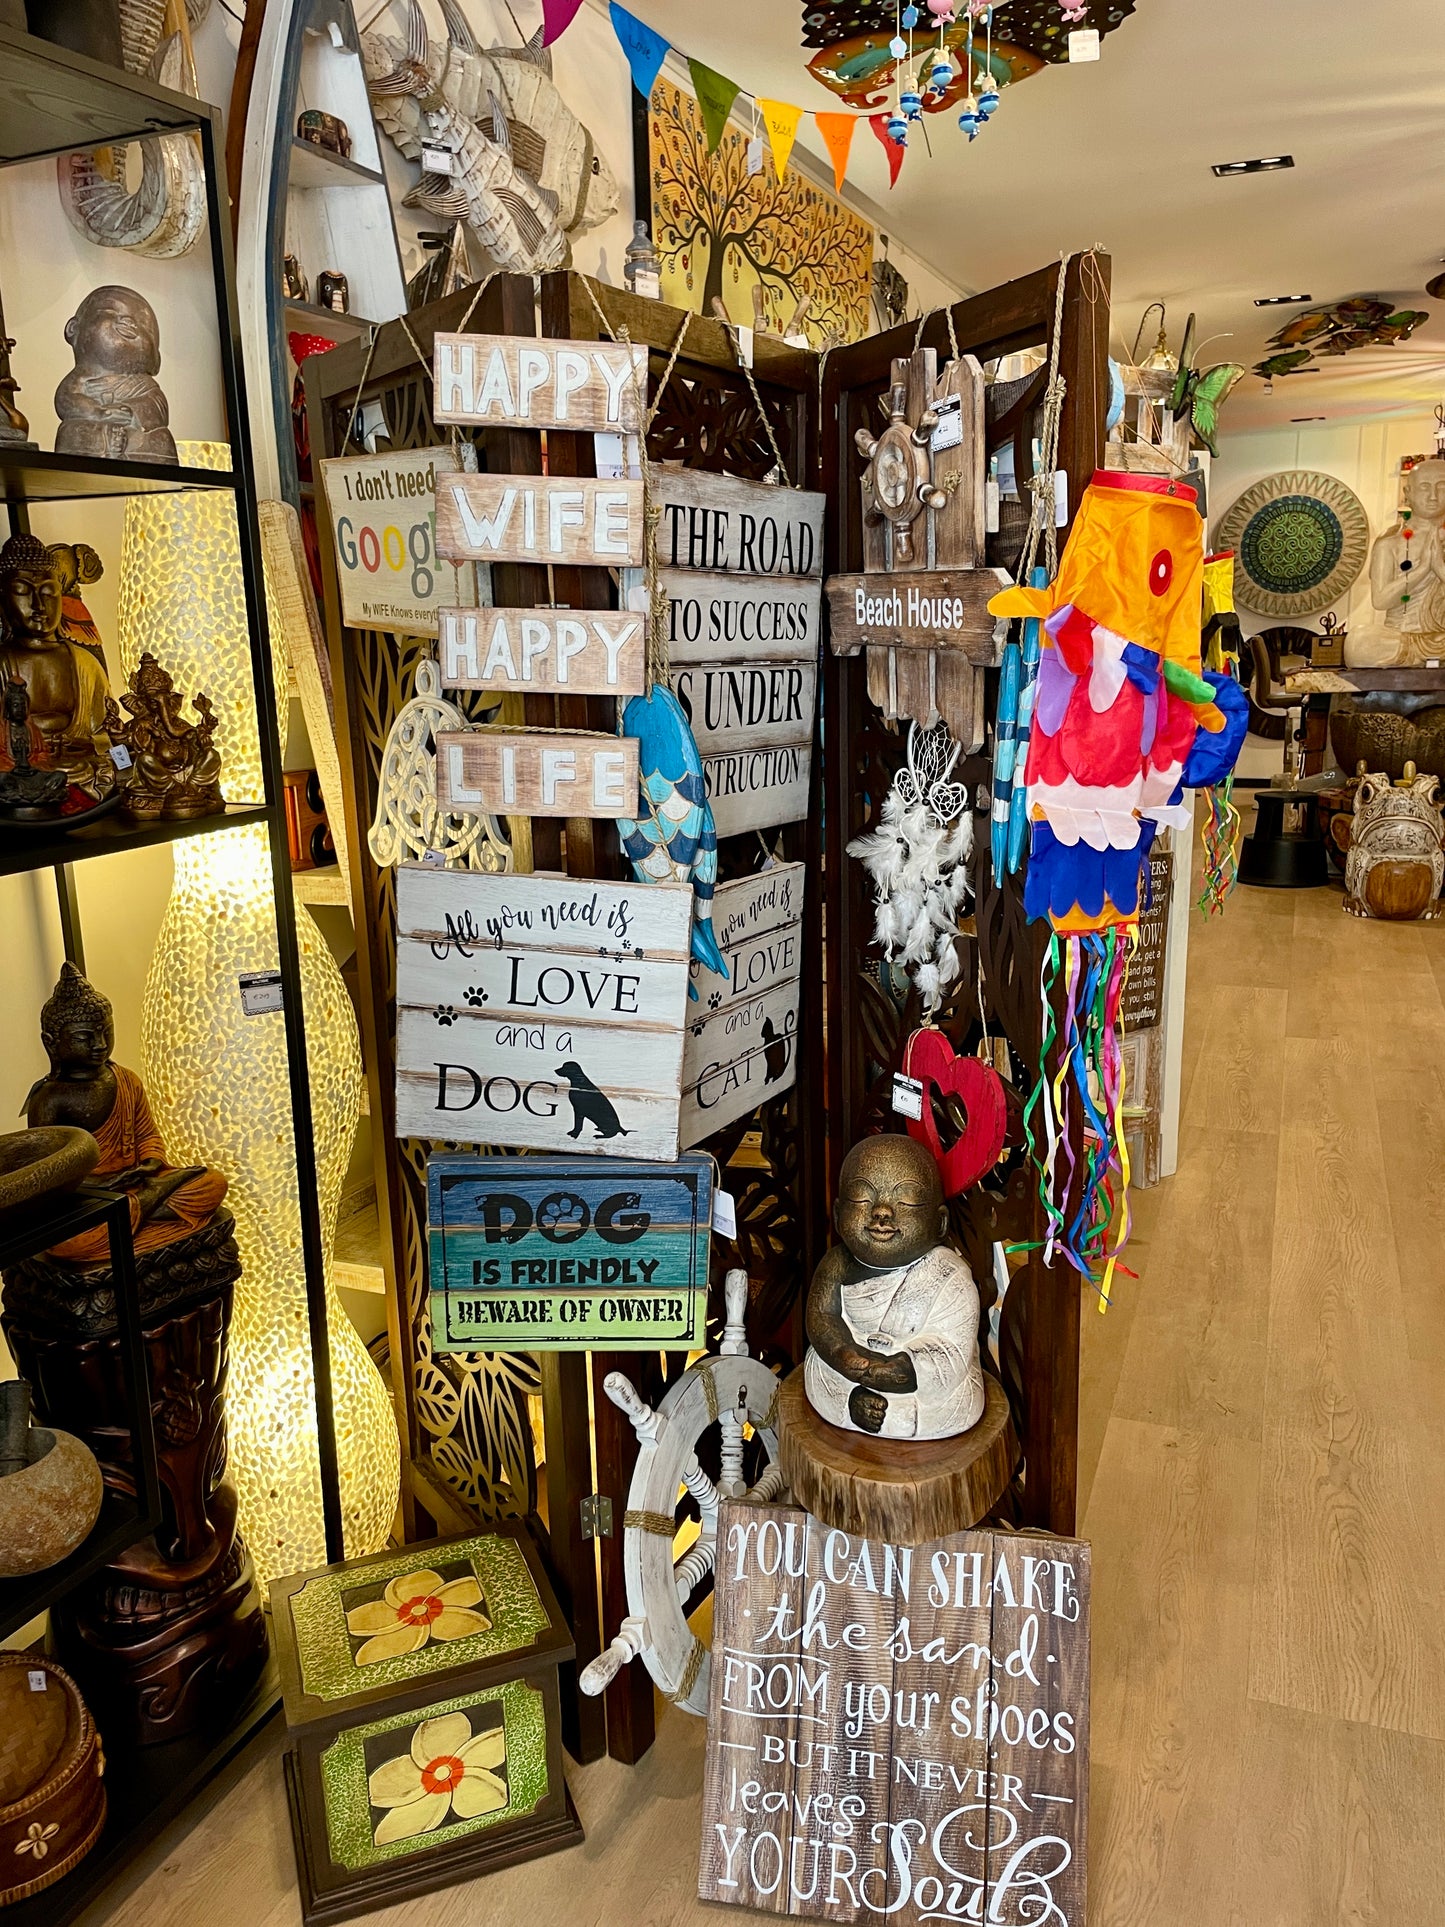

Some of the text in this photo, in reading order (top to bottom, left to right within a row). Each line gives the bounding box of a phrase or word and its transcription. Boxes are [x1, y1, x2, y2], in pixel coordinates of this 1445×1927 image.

[440, 344, 643, 422] HAPPY
[344, 462, 436, 502] I don't need
[451, 487, 629, 554] WIFE
[664, 503, 814, 575] THE ROAD
[362, 602, 371, 618] My
[373, 603, 390, 617] WIFE
[390, 605, 414, 620] Knows
[668, 599, 808, 642] TO SUCCESS
[855, 588, 964, 629] Beach House
[446, 616, 640, 684] HAPPY
[668, 668, 803, 732] S UNDER
[449, 746, 625, 807] LIFE
[430, 892, 633, 960] All you need is
[721, 878, 793, 953] you need is
[507, 956, 641, 1013] LOVE
[730, 936, 794, 996] LOVE
[495, 1023, 573, 1053] and a
[725, 1001, 764, 1035] and a
[433, 1063, 559, 1117] DOG
[696, 1046, 755, 1110] CAT
[475, 1192, 651, 1244] DOG
[472, 1257, 660, 1285] IS FRIENDLY
[457, 1298, 683, 1324] BEWARE OF OWNER
[728, 1521, 1080, 1622] YOU CAN SHAKE
[754, 1580, 871, 1651] the
[723, 1656, 1076, 1754] FROM your shoes
[730, 1768, 866, 1837] leaves
[761, 1735, 1034, 1812] BUT IT NEVER
[715, 1804, 1071, 1926] YOUR Soul
